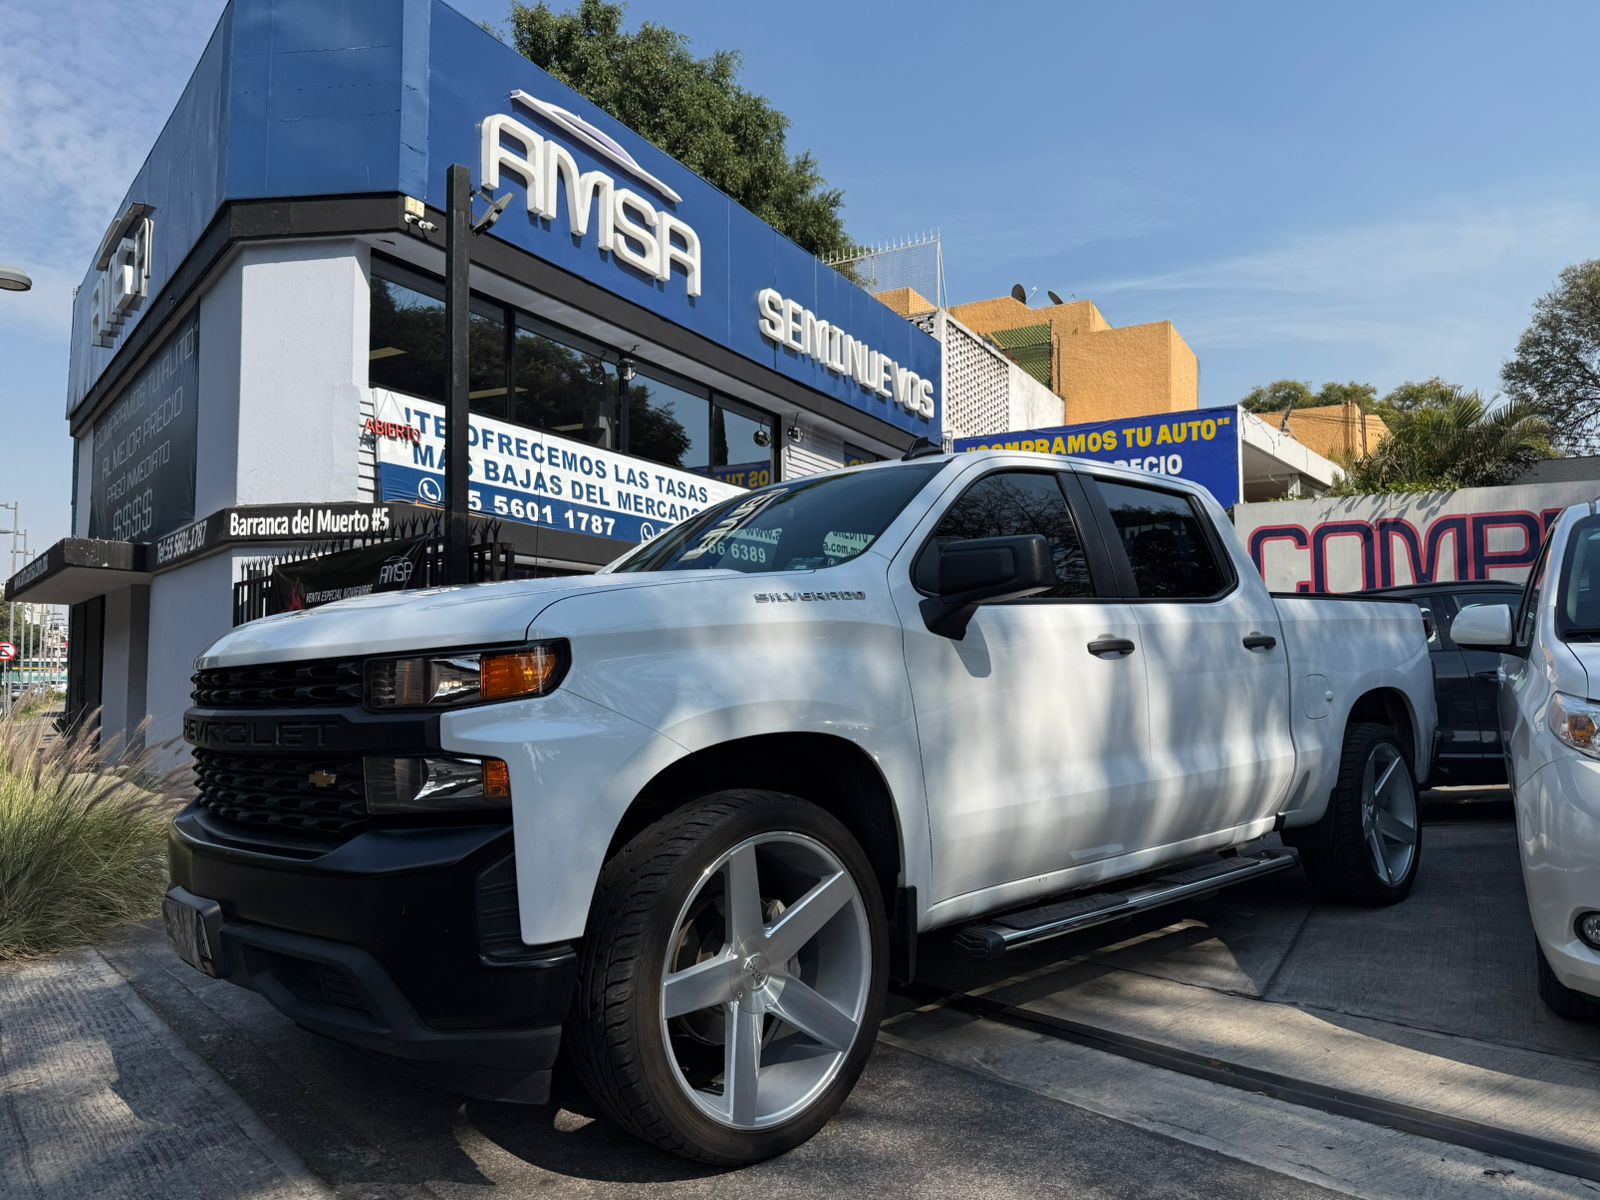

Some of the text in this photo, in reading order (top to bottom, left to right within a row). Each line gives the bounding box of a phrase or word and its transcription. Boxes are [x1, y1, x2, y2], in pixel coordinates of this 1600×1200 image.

[481, 113, 701, 297] AMSA
[758, 288, 934, 418] SEMINUEVOS
[143, 386, 183, 446] PRECIO
[364, 418, 421, 443] ABIERTO
[1123, 426, 1152, 448] TU
[1156, 417, 1230, 445] AUTO"
[469, 424, 607, 479] OFRECEMOS
[614, 464, 649, 489] LAS
[655, 475, 708, 503] TASAS
[484, 459, 563, 496] BAJAS
[571, 480, 610, 506] DEL
[230, 508, 390, 536] Barranca del Muerto #5
[494, 495, 552, 524] 5601
[564, 508, 616, 536] 1787
[730, 543, 766, 563] 6389
[1248, 507, 1563, 594] COMP
[379, 562, 413, 584] AMSA
[753, 591, 867, 603] SILVERADO
